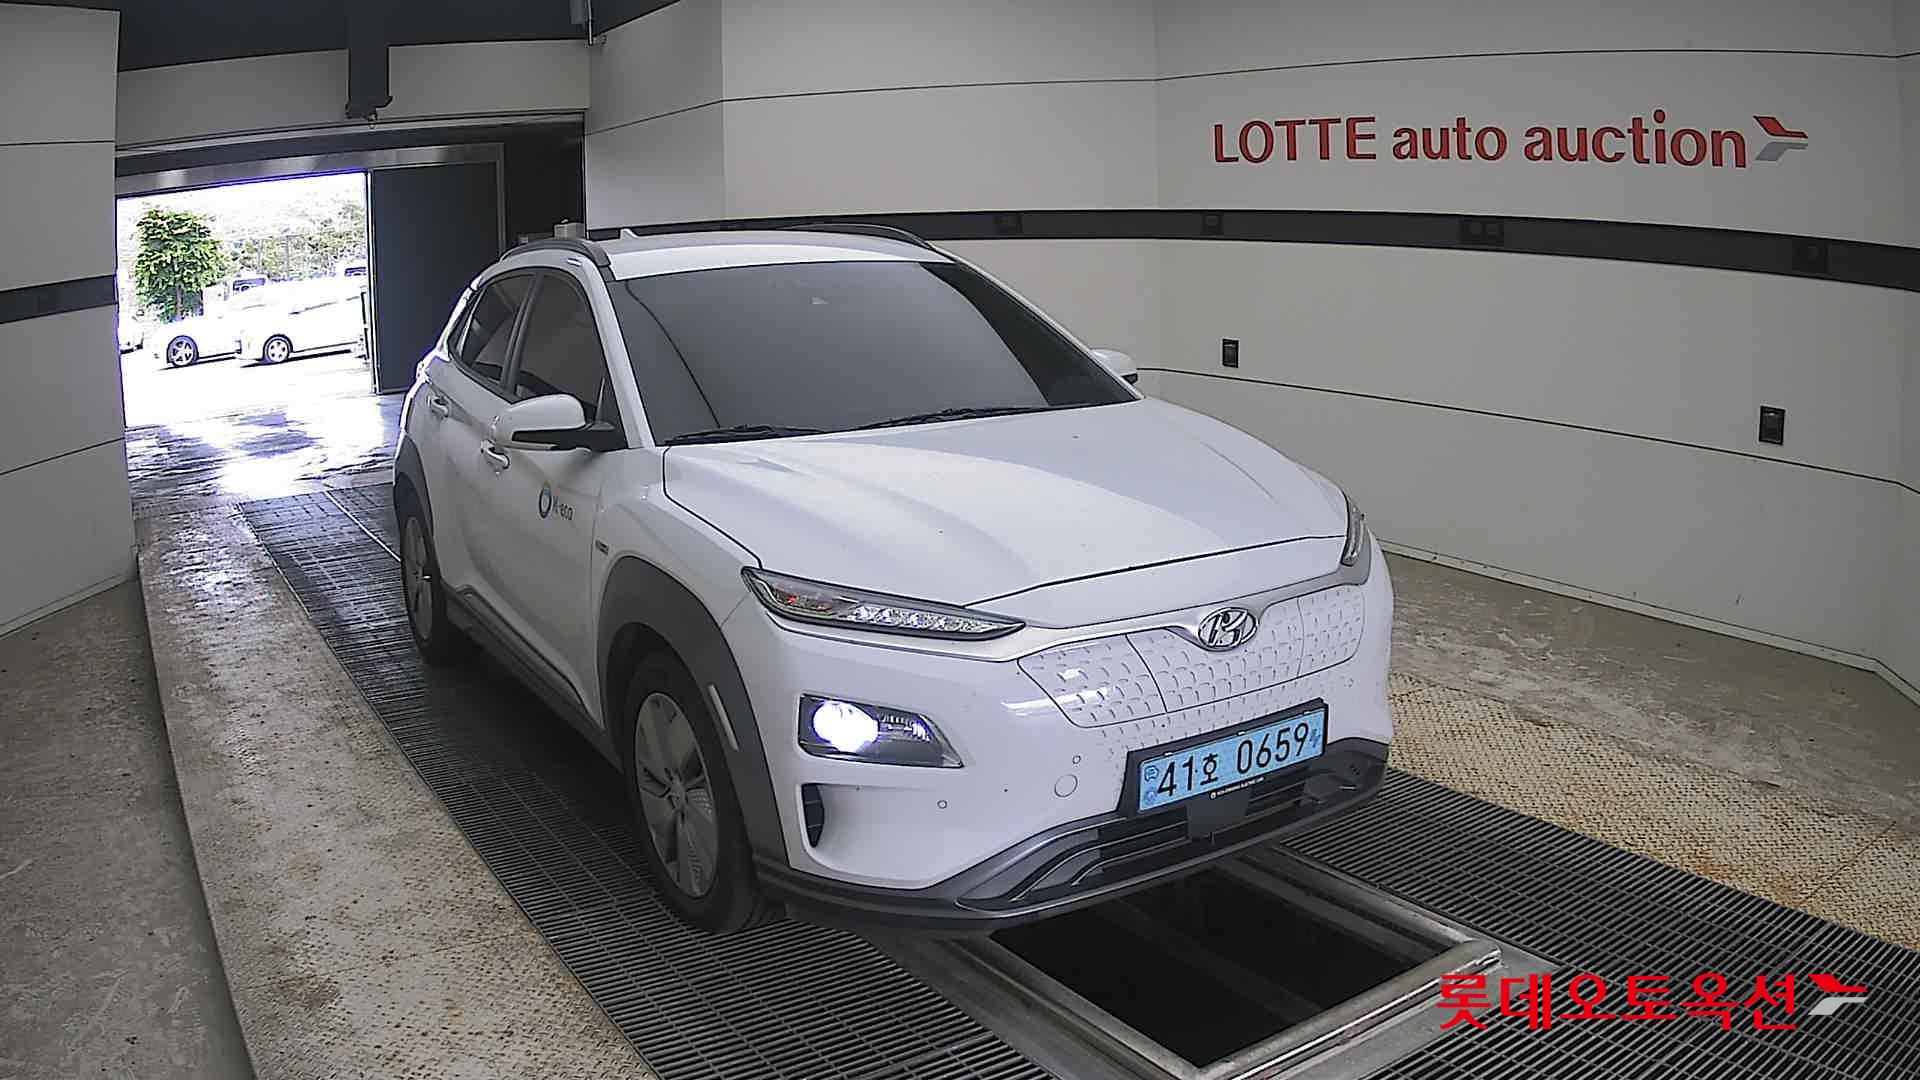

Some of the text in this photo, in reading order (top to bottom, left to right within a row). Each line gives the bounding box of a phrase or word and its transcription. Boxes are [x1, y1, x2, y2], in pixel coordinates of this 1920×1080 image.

[1213, 109, 1748, 169] LOTTE auto auction
[1157, 752, 1219, 797] 41호
[1236, 722, 1310, 775] 0659
